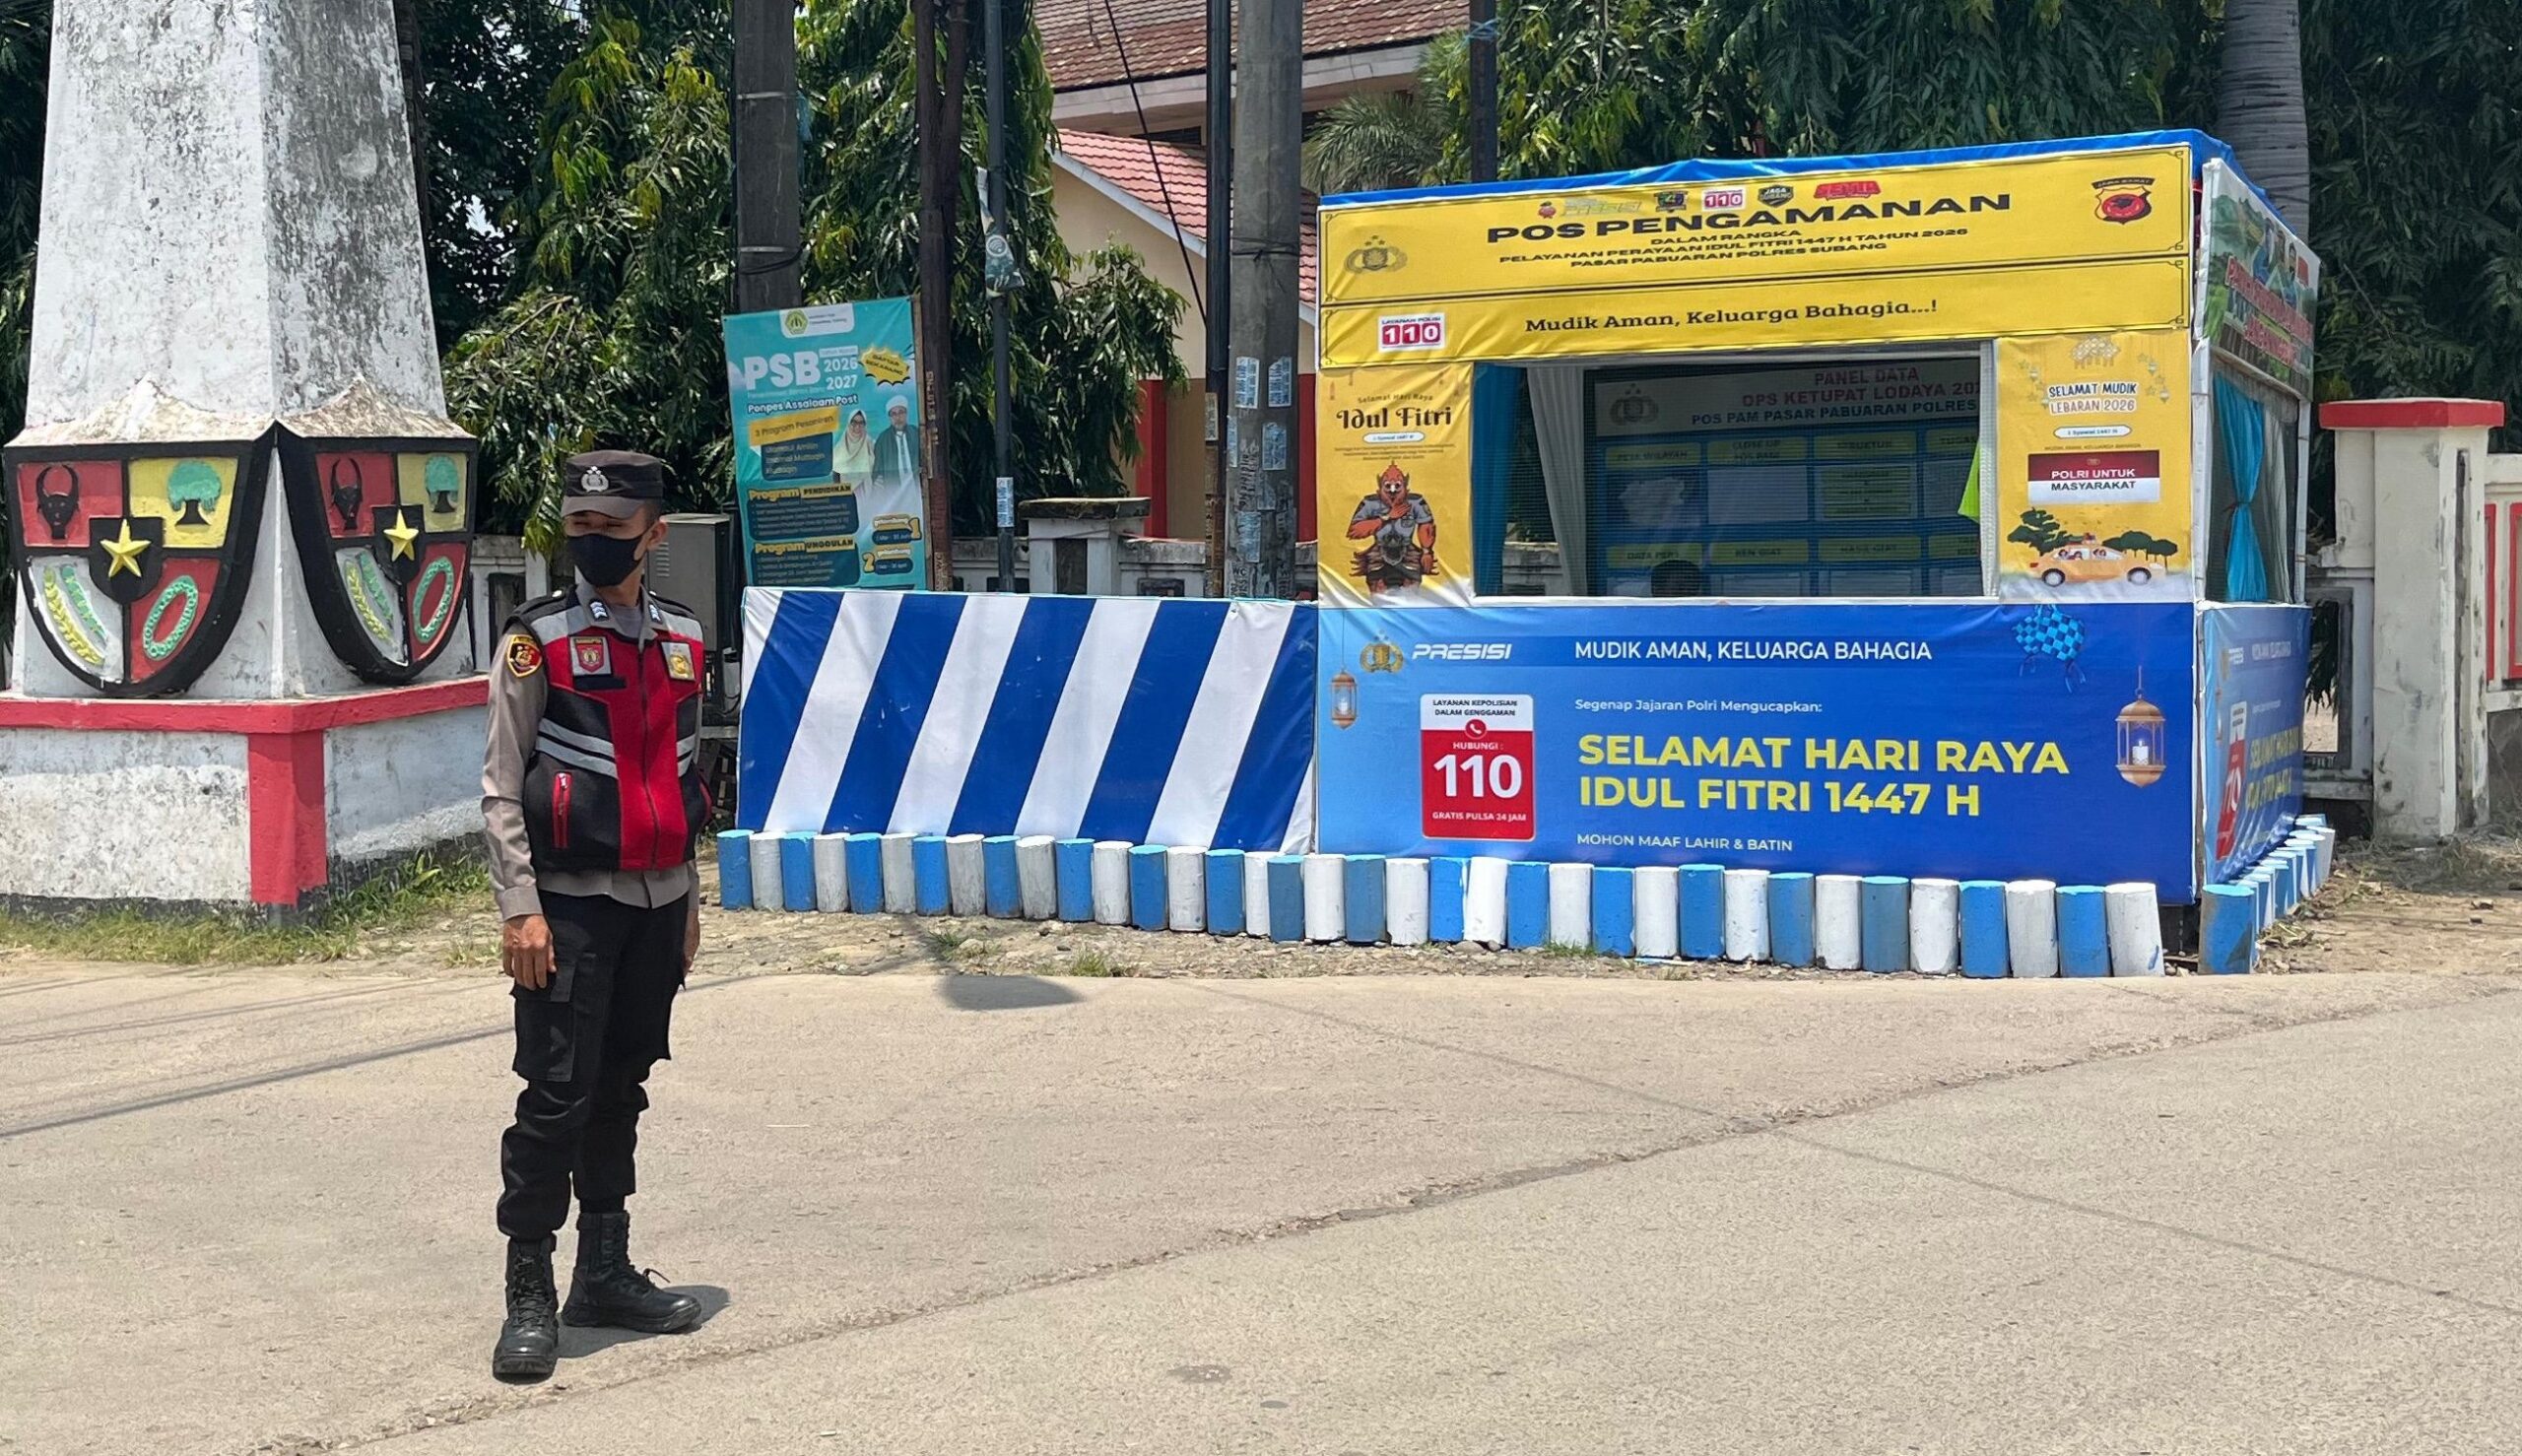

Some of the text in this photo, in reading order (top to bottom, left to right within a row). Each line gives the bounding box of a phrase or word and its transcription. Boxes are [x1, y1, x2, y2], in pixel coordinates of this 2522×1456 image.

[1706, 194, 1742, 207] 110
[1488, 194, 2011, 243] POS PENGAMANAN
[1499, 228, 1968, 263] PELAYANAN PERAYAAN IDUL FITRI 1447 H TAHUN 2026
[1651, 230, 1802, 245] DALAM RANGKA
[1570, 242, 1887, 267] PASAR PABUARAN POLRES SUBANG
[1525, 298, 1938, 332] Mudik Aman, Keluarga Bahagia...!
[1384, 325, 1438, 343] 110
[743, 351, 821, 391] PSB
[823, 357, 858, 372] 2026
[1815, 367, 1920, 385] PANEL DATA
[826, 374, 858, 390] 2027
[2048, 382, 2137, 398] SELAMAT MUDIK
[1358, 394, 1390, 404] Selamat
[1742, 394, 1777, 407] OPS
[1784, 387, 1867, 405] KETUPAT
[1873, 383, 1944, 400] LODAYA
[748, 394, 859, 416] Ponpes Assalaam Post
[1692, 399, 1978, 425] POS PAM PASAR PABUARAN POLRES
[2050, 399, 2136, 414] LEBARAN 2026
[1336, 406, 1451, 430] Idul Fitri
[2051, 468, 2136, 480] POLRI UNTUK
[2050, 481, 2137, 492] MASYARAKAT
[1411, 643, 1513, 660] PRESISI
[1575, 641, 1933, 662] MUDIK AMAN, KELUARGA BAHAGIA
[1575, 698, 1823, 714] Segenap Jajaran Polri Mengucapkan:
[1453, 741, 1499, 751] HUBUNGI
[1578, 734, 2070, 774] SELAMAT HARI RAYA
[1433, 755, 1523, 799] 110
[1580, 776, 1979, 817] IDUL FITRI 1447 H
[1432, 811, 1527, 823] GRATIS PULSA 24 JAM
[1576, 833, 1793, 851] MOHON MAAF LAHIR & BATIN
